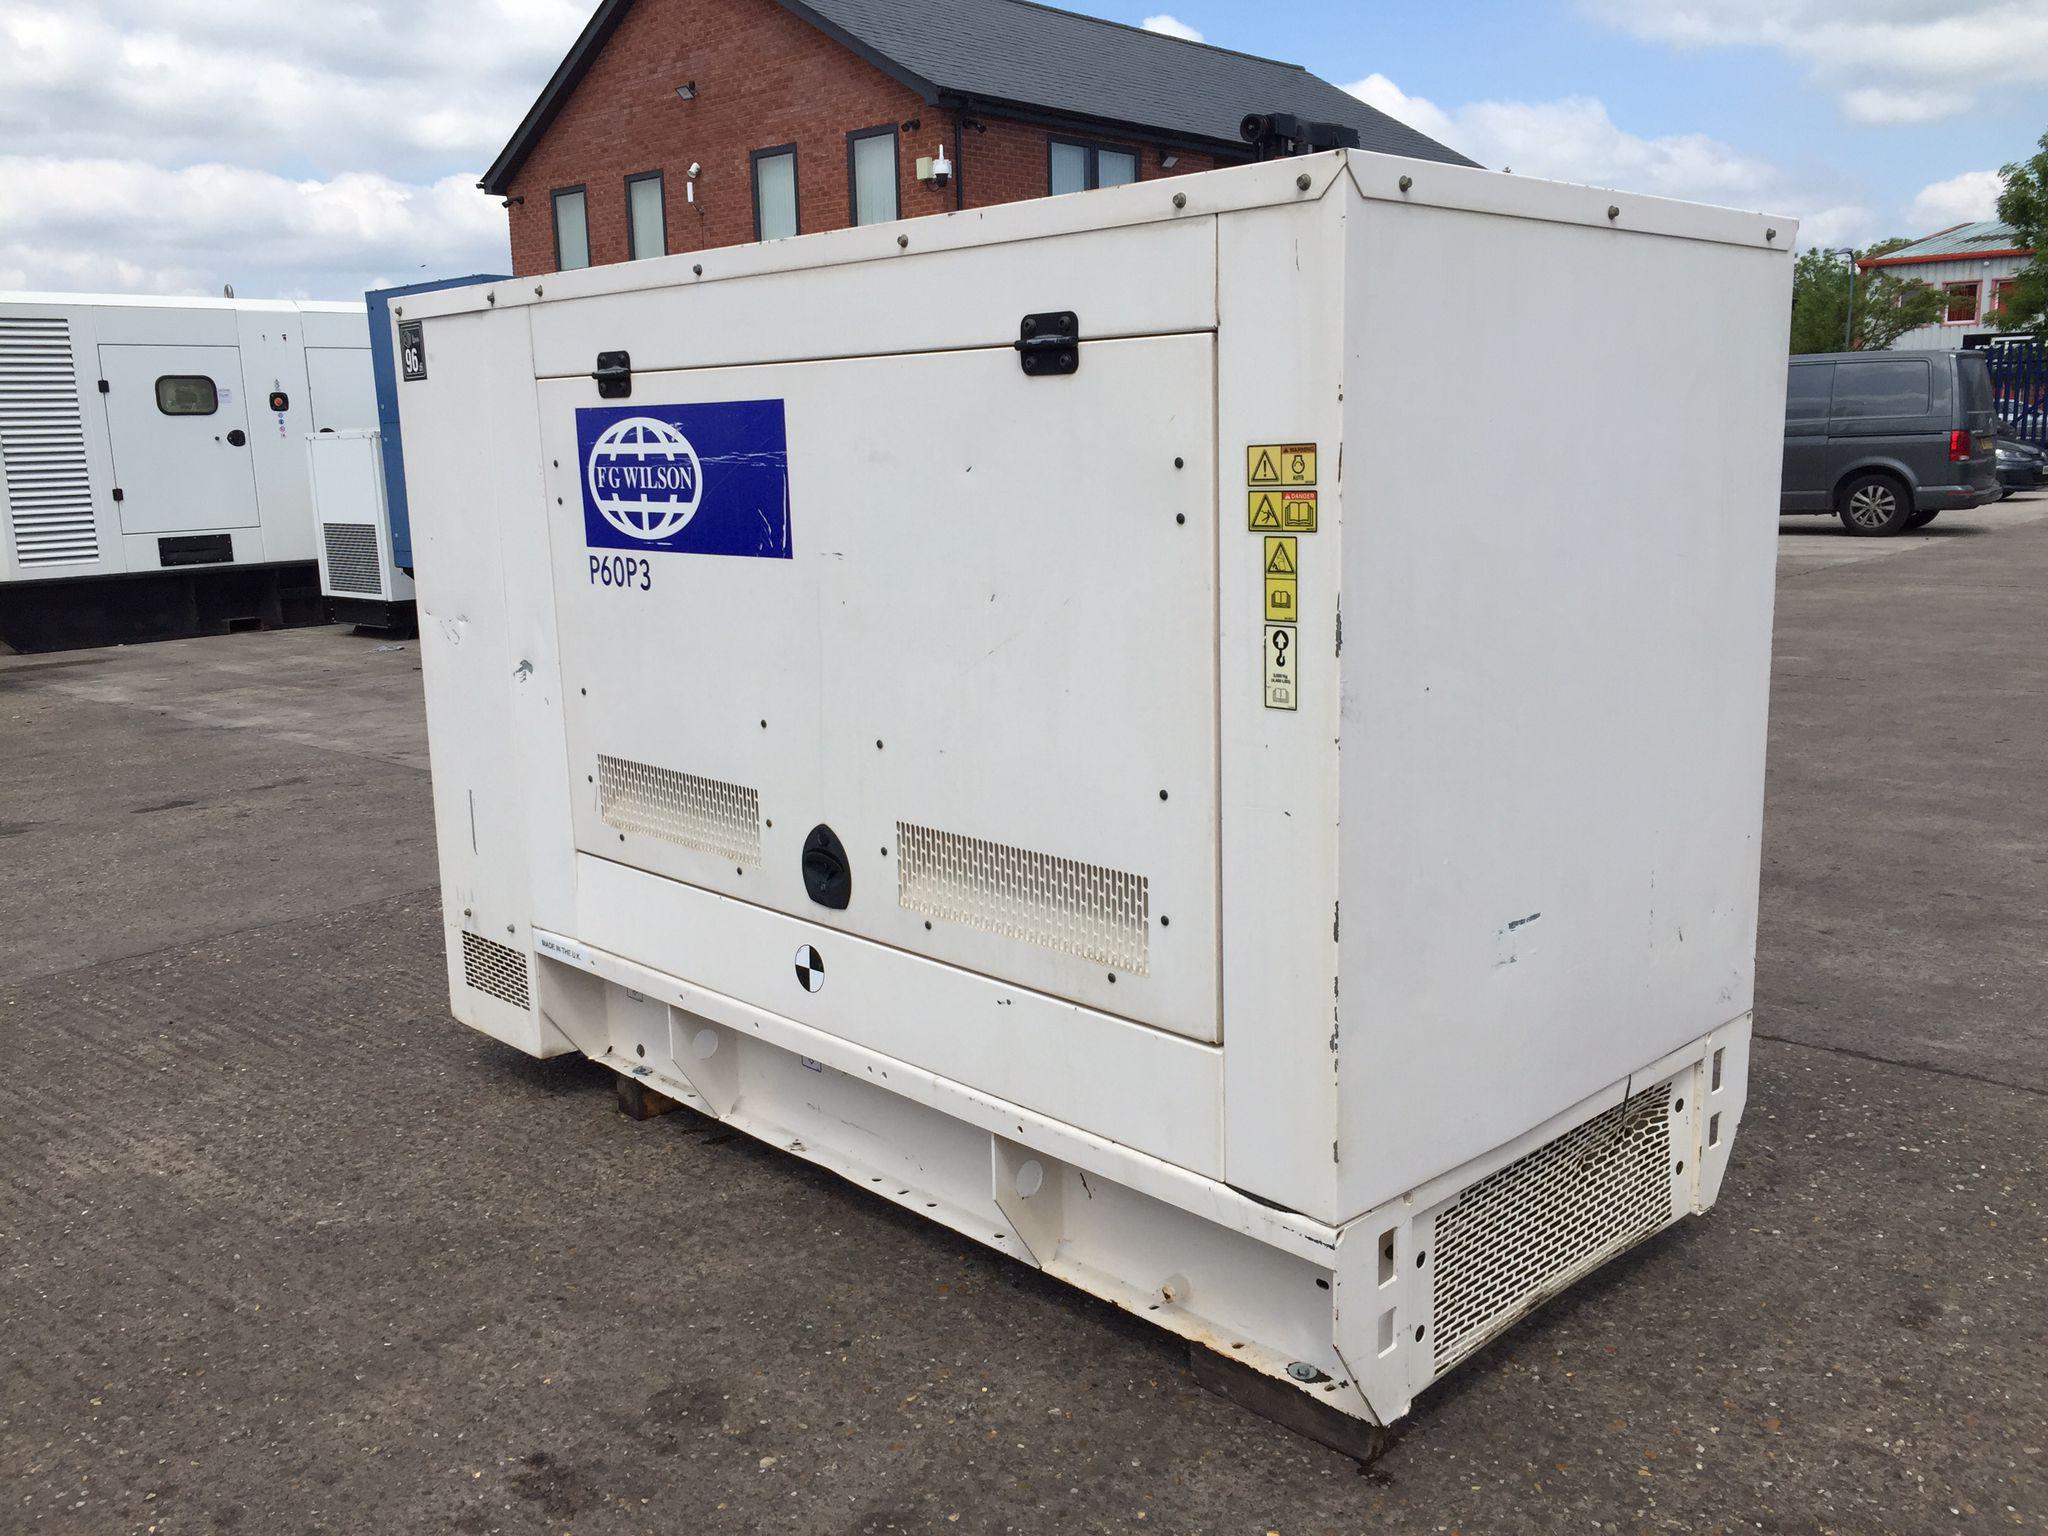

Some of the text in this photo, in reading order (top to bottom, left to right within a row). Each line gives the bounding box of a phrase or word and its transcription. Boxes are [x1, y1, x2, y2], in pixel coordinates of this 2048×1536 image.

[405, 347, 418, 373] 96
[622, 466, 693, 490] WILSON
[589, 555, 651, 591] P60P3
